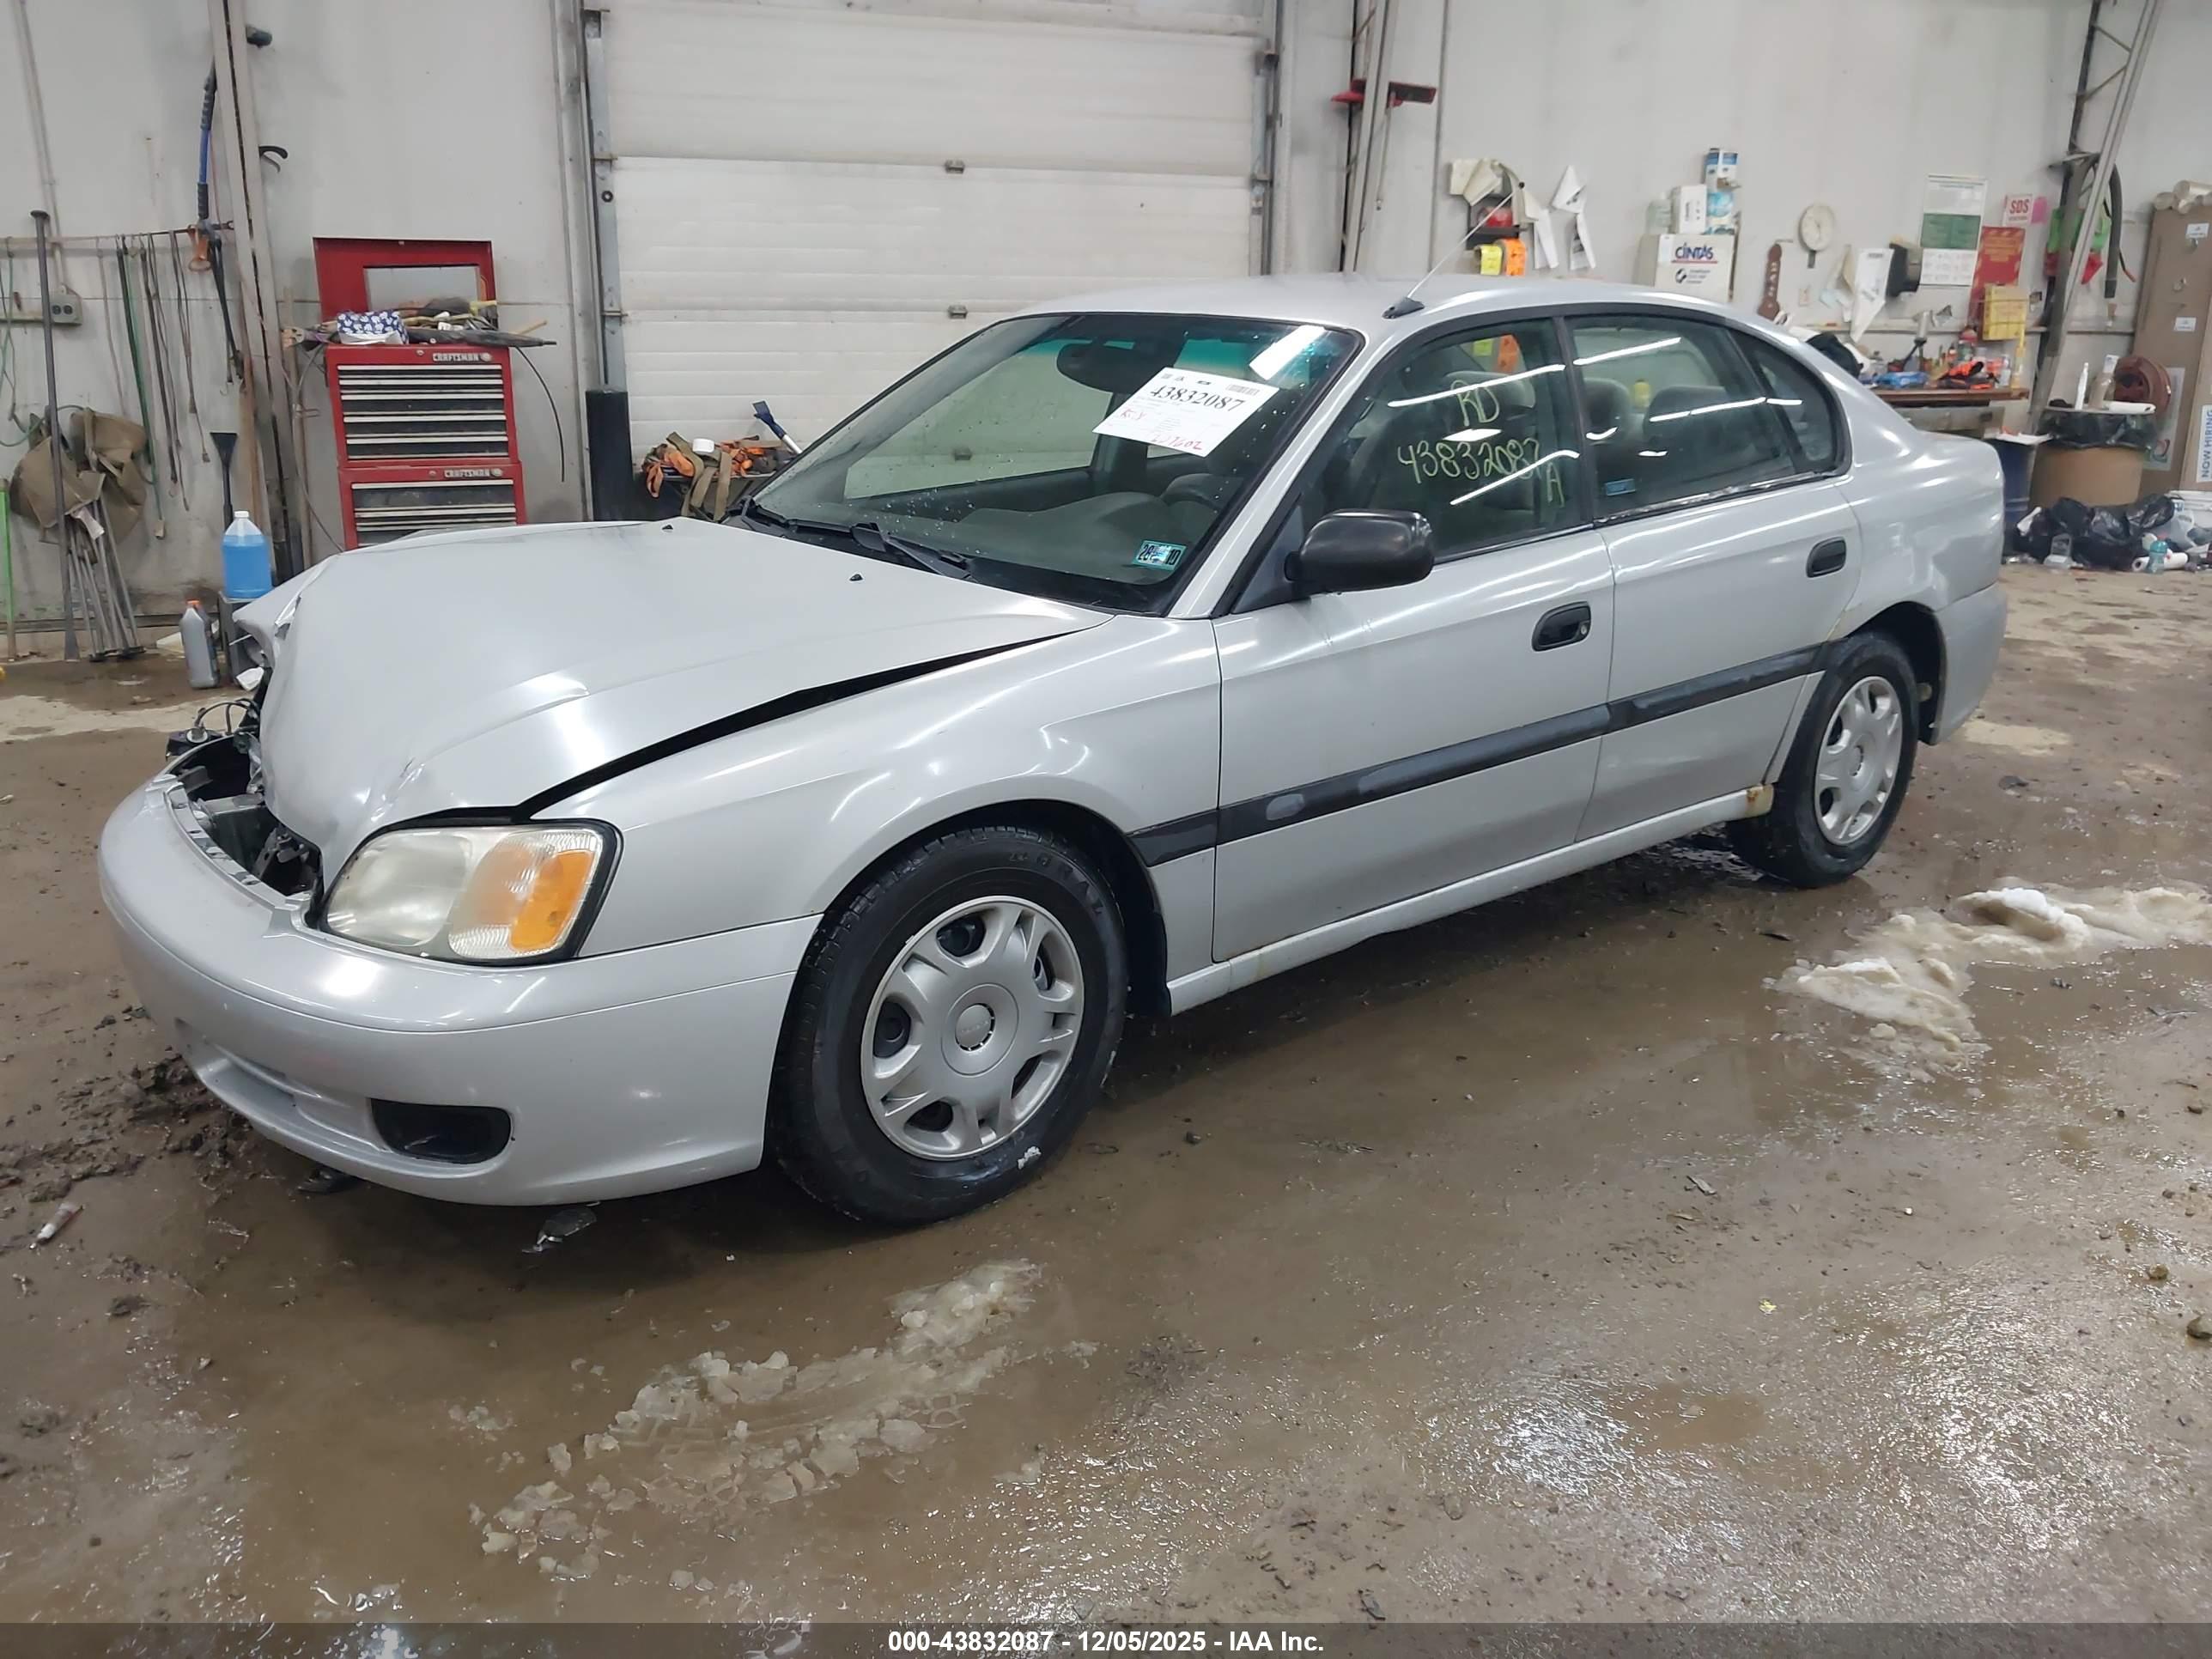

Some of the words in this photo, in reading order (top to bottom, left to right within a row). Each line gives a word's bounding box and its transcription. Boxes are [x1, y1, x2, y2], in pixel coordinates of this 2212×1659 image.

[2010, 198, 2029, 214] SDS
[1675, 242, 1714, 259] CINTAS
[1150, 384, 1246, 411] 43832087
[2203, 410, 2212, 447] HIRING
[1397, 437, 1542, 484] 43832087
[2201, 450, 2211, 477] NOW
